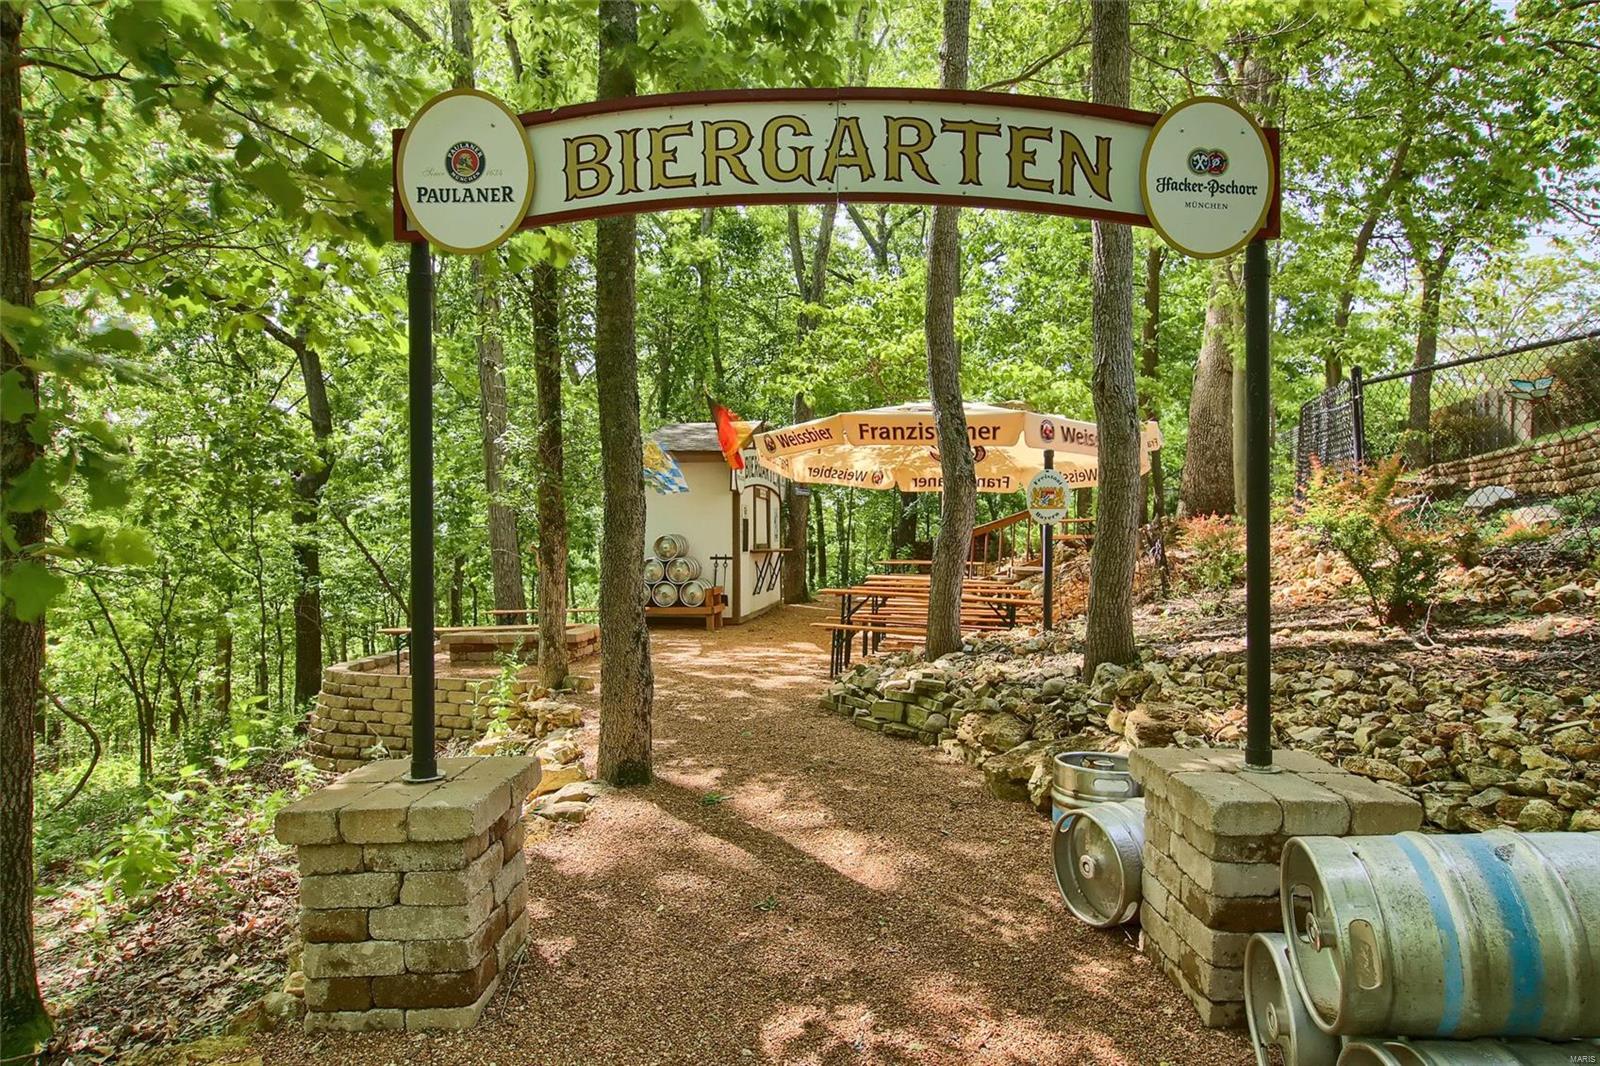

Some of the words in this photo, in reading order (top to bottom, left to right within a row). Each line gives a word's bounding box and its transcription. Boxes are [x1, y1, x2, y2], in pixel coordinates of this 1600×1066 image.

[563, 115, 1113, 203] BIERGARTEN
[416, 186, 515, 203] PAULANER
[1156, 177, 1258, 198] Hacker-Pschorr
[1184, 201, 1229, 210] MÜNCHEN
[776, 427, 833, 449] Weissbier
[859, 423, 1000, 440] Franzisner
